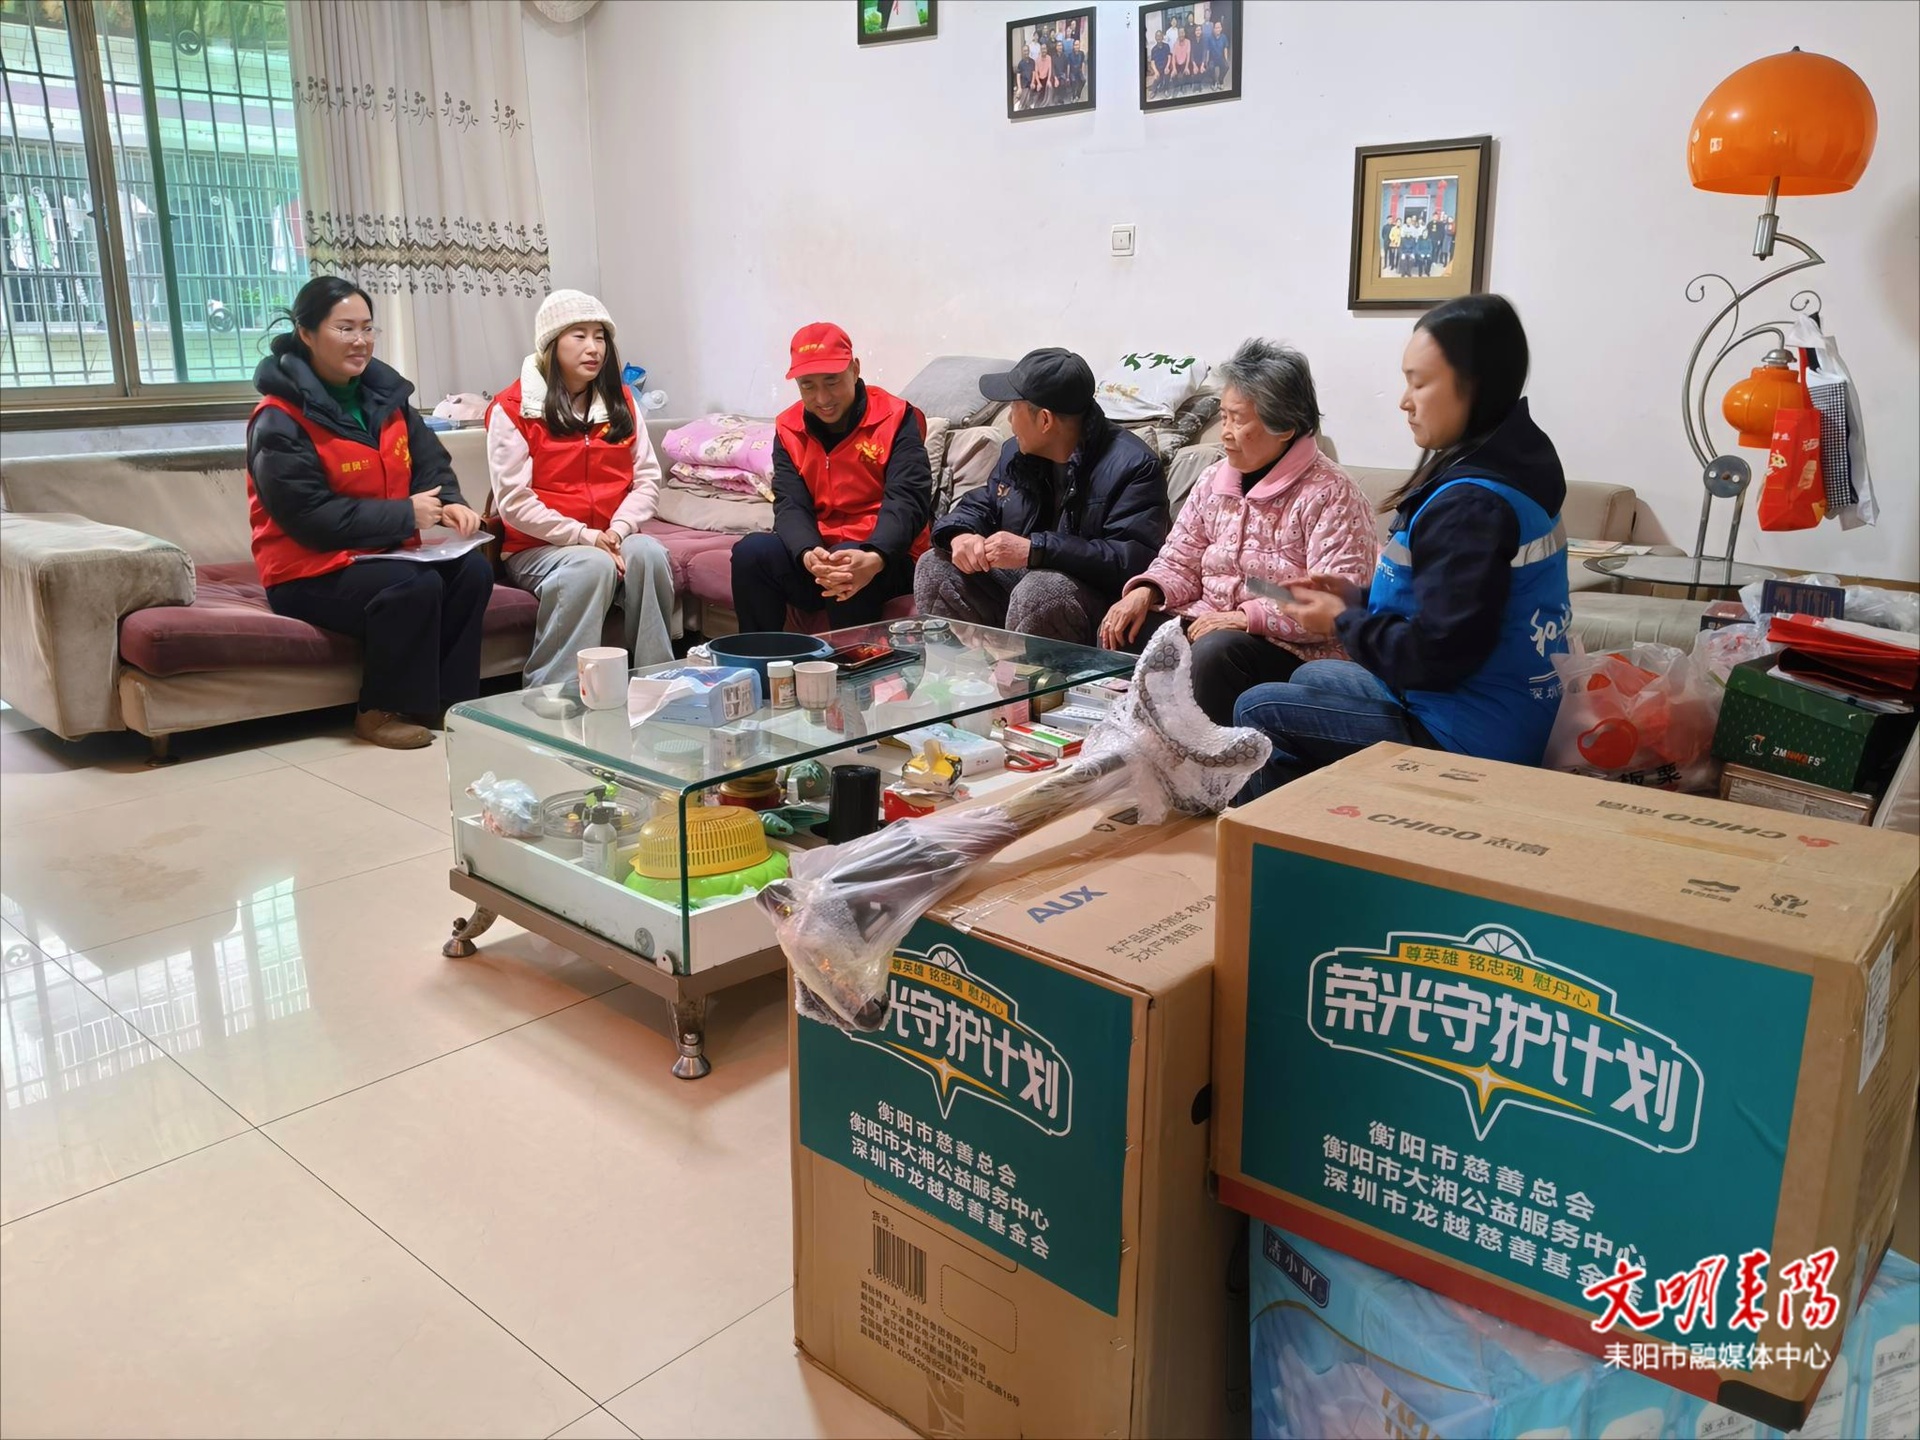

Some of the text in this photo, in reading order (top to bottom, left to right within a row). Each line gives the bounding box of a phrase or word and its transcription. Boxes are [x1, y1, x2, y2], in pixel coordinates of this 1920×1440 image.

[1367, 813, 1551, 857] CHIGO 志高
[1662, 813, 1787, 839] CHIGO
[1027, 886, 1107, 924] AUX
[892, 959, 1004, 1015] 尊英雄 铭忠魂 慰丹心
[1405, 945, 1592, 1009] 尊英雄 铭忠魂 慰丹心
[879, 979, 1059, 1119] 光守护计划
[1325, 963, 1682, 1132] 荣光守护计划
[850, 1111, 1050, 1231] 衡阳市大湘公益服务中心
[878, 1100, 1017, 1188] 衡阳市慈善总会
[1369, 1120, 1595, 1222] 衡阳市慈善总会
[852, 1135, 1050, 1260] 深圳市龙越慈善基金会
[1322, 1134, 1646, 1270] 衡阳市大湘公益服务中心
